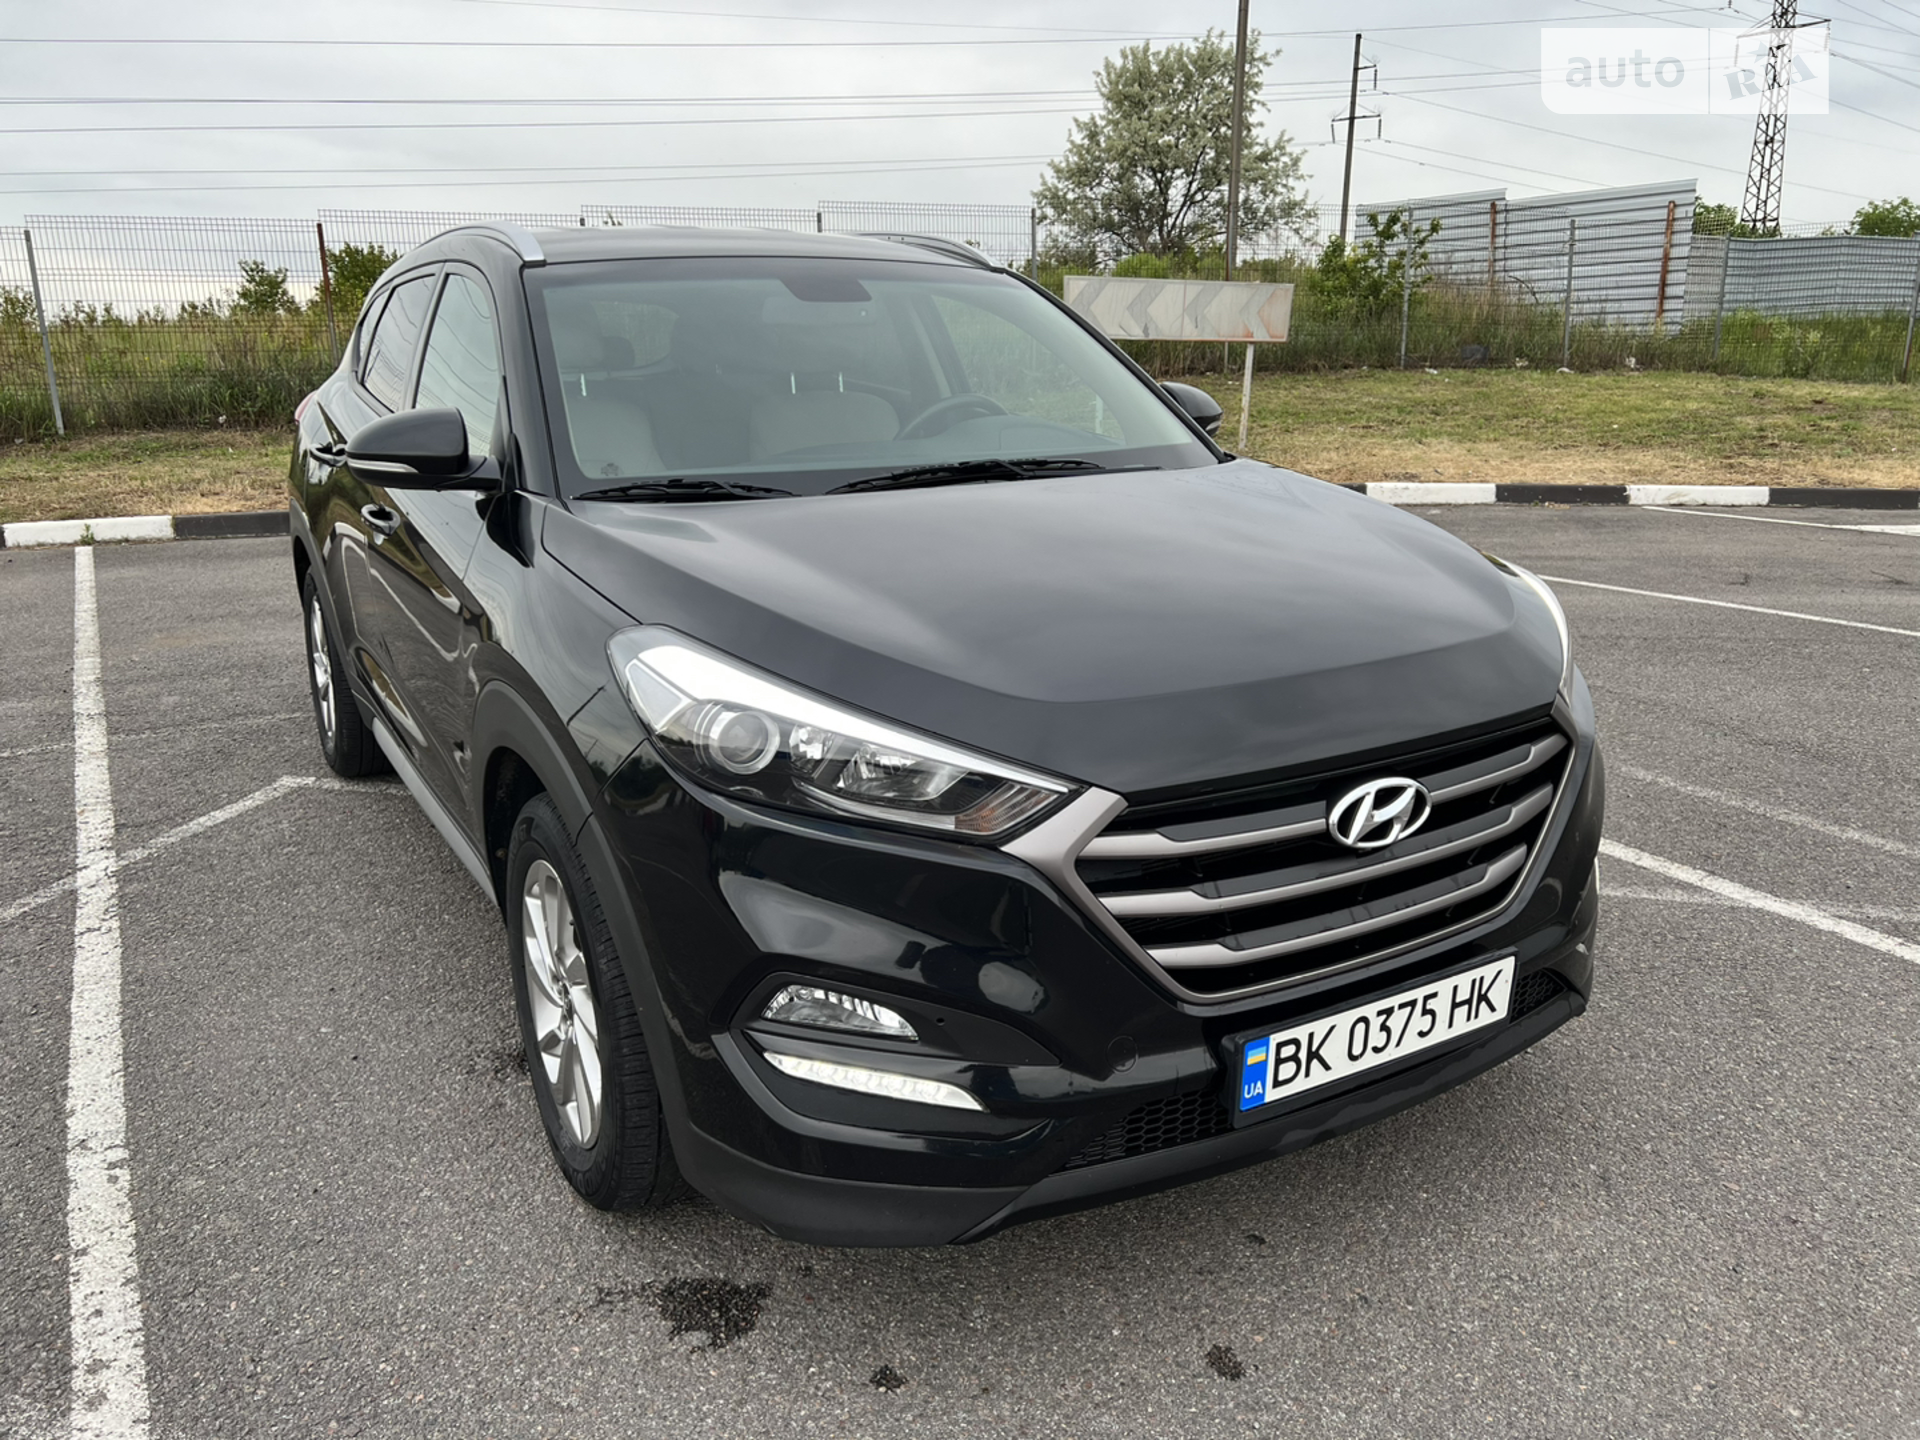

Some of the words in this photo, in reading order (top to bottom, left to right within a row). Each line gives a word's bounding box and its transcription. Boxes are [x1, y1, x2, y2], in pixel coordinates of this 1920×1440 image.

[1271, 1024, 1337, 1089] BK
[1347, 991, 1439, 1062] 0375
[1448, 968, 1503, 1030] HK
[1244, 1080, 1264, 1099] UA
